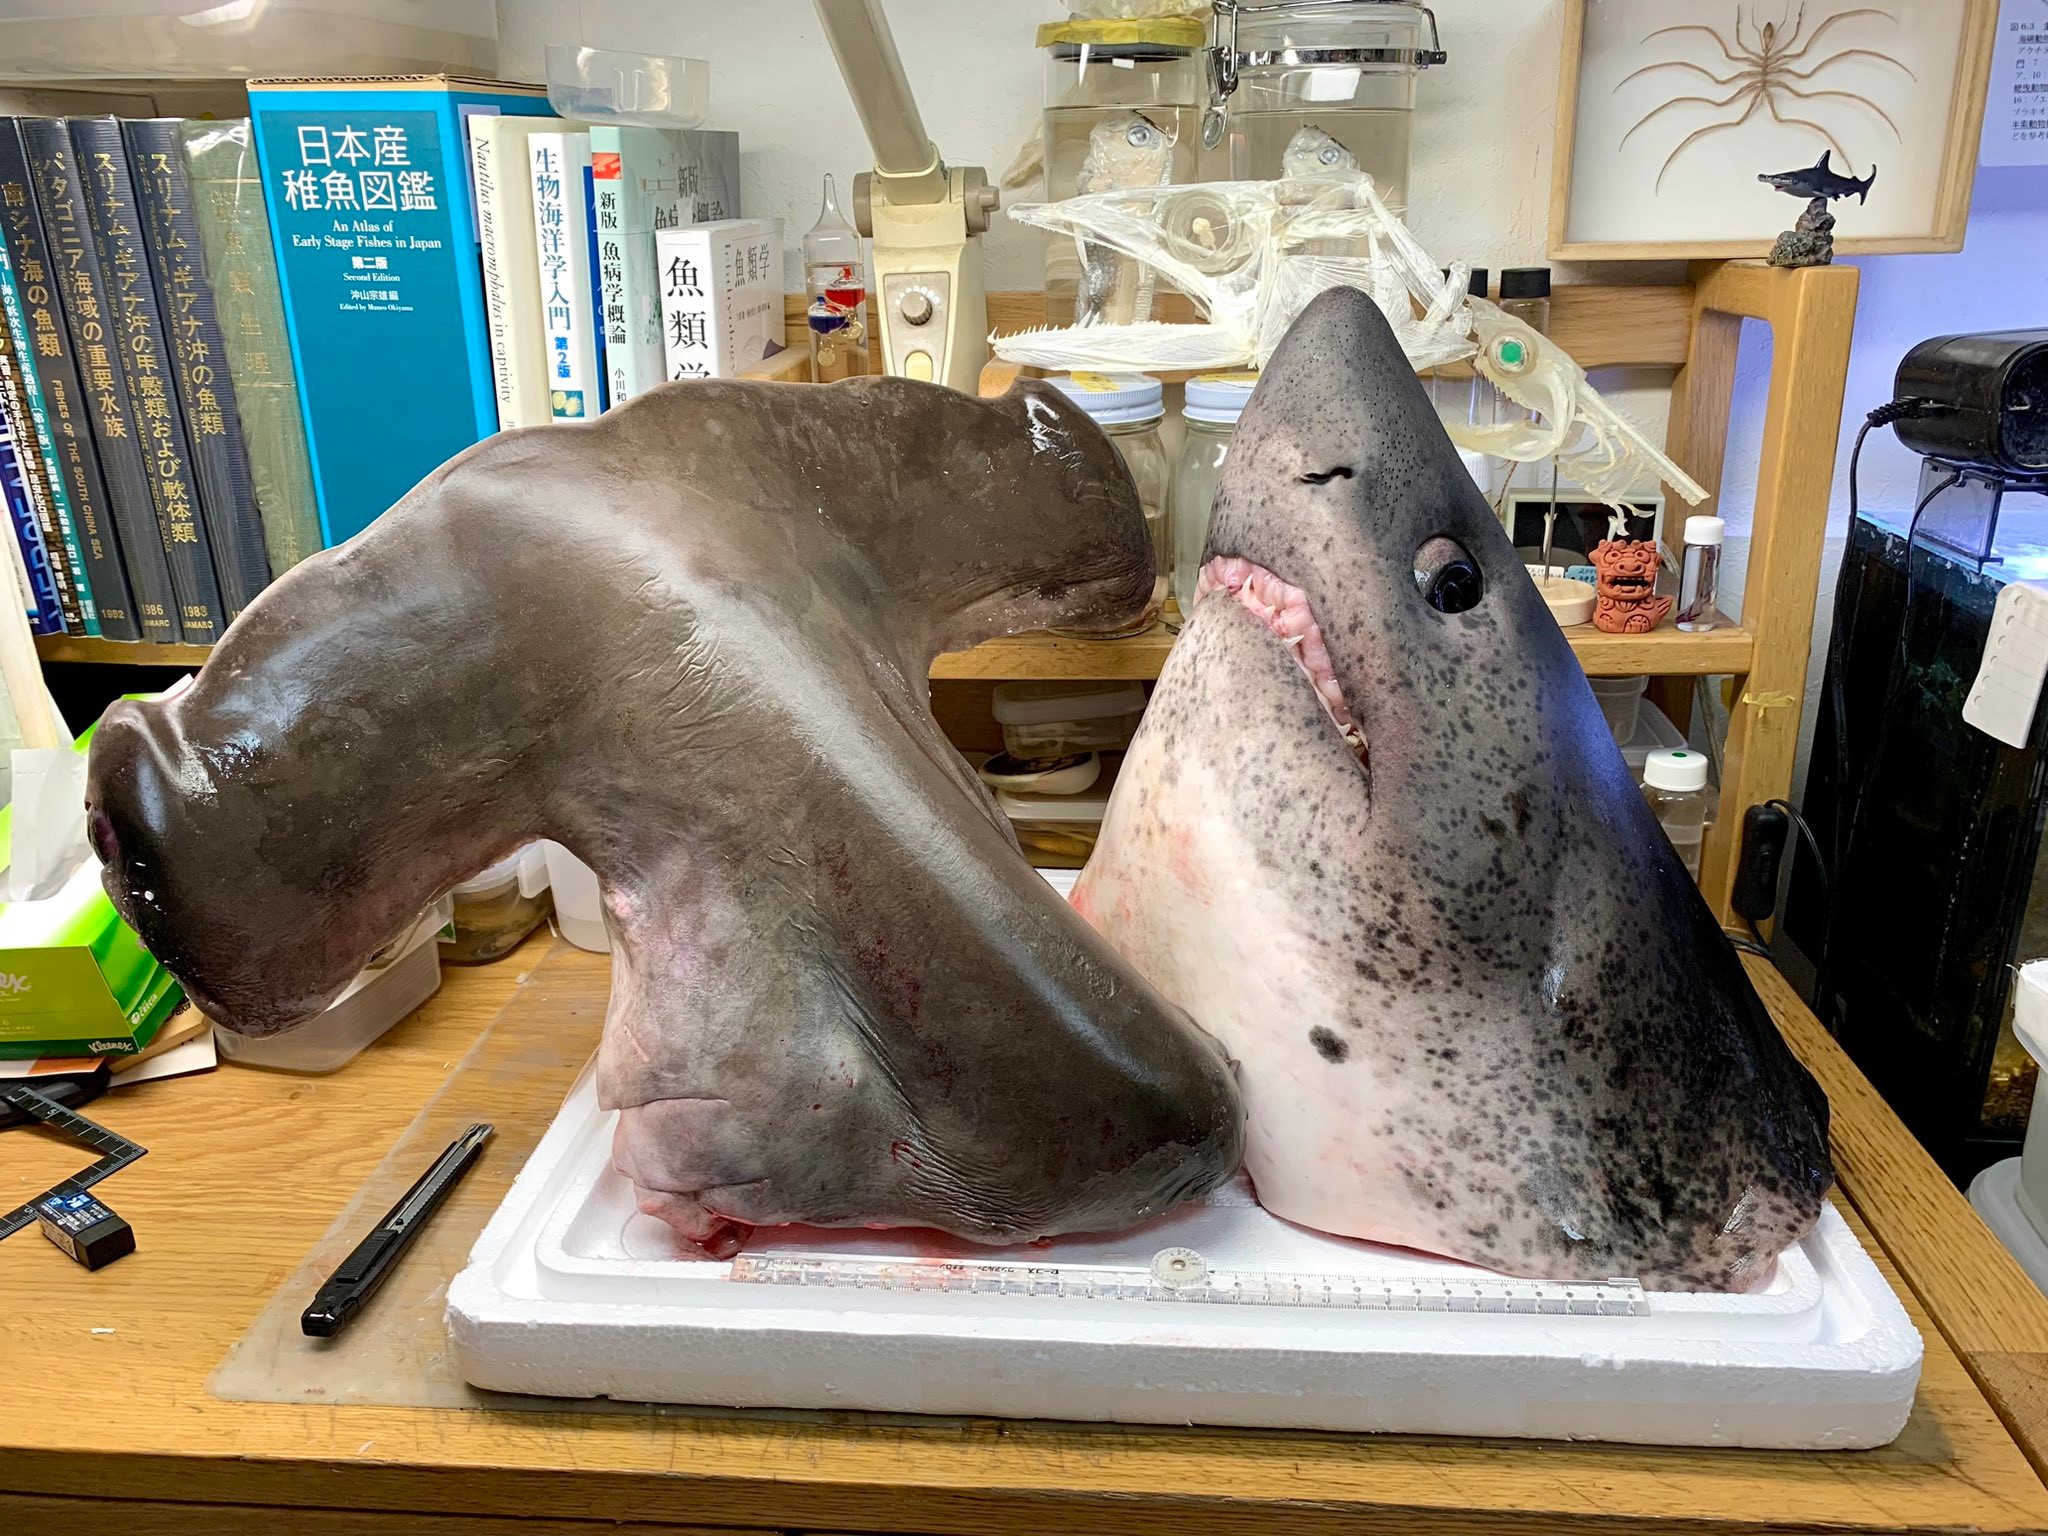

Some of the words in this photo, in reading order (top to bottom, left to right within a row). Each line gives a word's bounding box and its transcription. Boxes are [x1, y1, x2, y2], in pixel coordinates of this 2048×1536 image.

[297, 125, 411, 167] 日本産
[475, 137, 495, 206] Nautilus
[676, 166, 698, 198] 新版
[281, 169, 438, 212] 稚魚図鑑
[333, 220, 349, 232] An
[351, 220, 380, 232] Atlas
[382, 220, 394, 232] of
[599, 192, 618, 229] 新版
[293, 235, 322, 250] Early
[324, 235, 354, 249] Stage
[356, 235, 393, 248] Fishes
[395, 236, 407, 248] in
[409, 236, 442, 251] Japan
[343, 272, 371, 282] Second
[372, 273, 401, 282] Edition
[351, 256, 388, 270] 第二版
[483, 208, 507, 320] macromphalus
[536, 148, 571, 331] 生物海洋学入門
[554, 337, 571, 378] 第2版
[734, 243, 770, 288] 魚類学
[43, 151, 127, 439] パタゴニア海域の重要水族
[151, 153, 226, 436] スリナム・ギアナ沖の魚類
[163, 281, 181, 336] SURINAME
[339, 303, 359, 311] Edited
[359, 304, 367, 312] by
[602, 241, 627, 344] 魚病学概論
[57, 261, 75, 312] TRAWLED
[69, 313, 81, 336] OFF
[76, 338, 94, 393] PATAGONIA
[494, 324, 505, 338] in
[174, 337, 186, 360] AND
[179, 362, 193, 403] FRENCH
[495, 341, 511, 403] captivity
[52, 379, 69, 420] FISHES
[63, 422, 75, 438] OF
[131, 400, 148, 451] SURINAME
[188, 406, 202, 443] GUIANA
[67, 441, 81, 463] THE
[73, 465, 89, 501] SOUTH
[82, 505, 97, 536] CHINA
[90, 538, 103, 560] SEA
[101, 609, 125, 619] 1982
[141, 604, 164, 616] 1986
[88, 1041, 133, 1054] Kleenex
